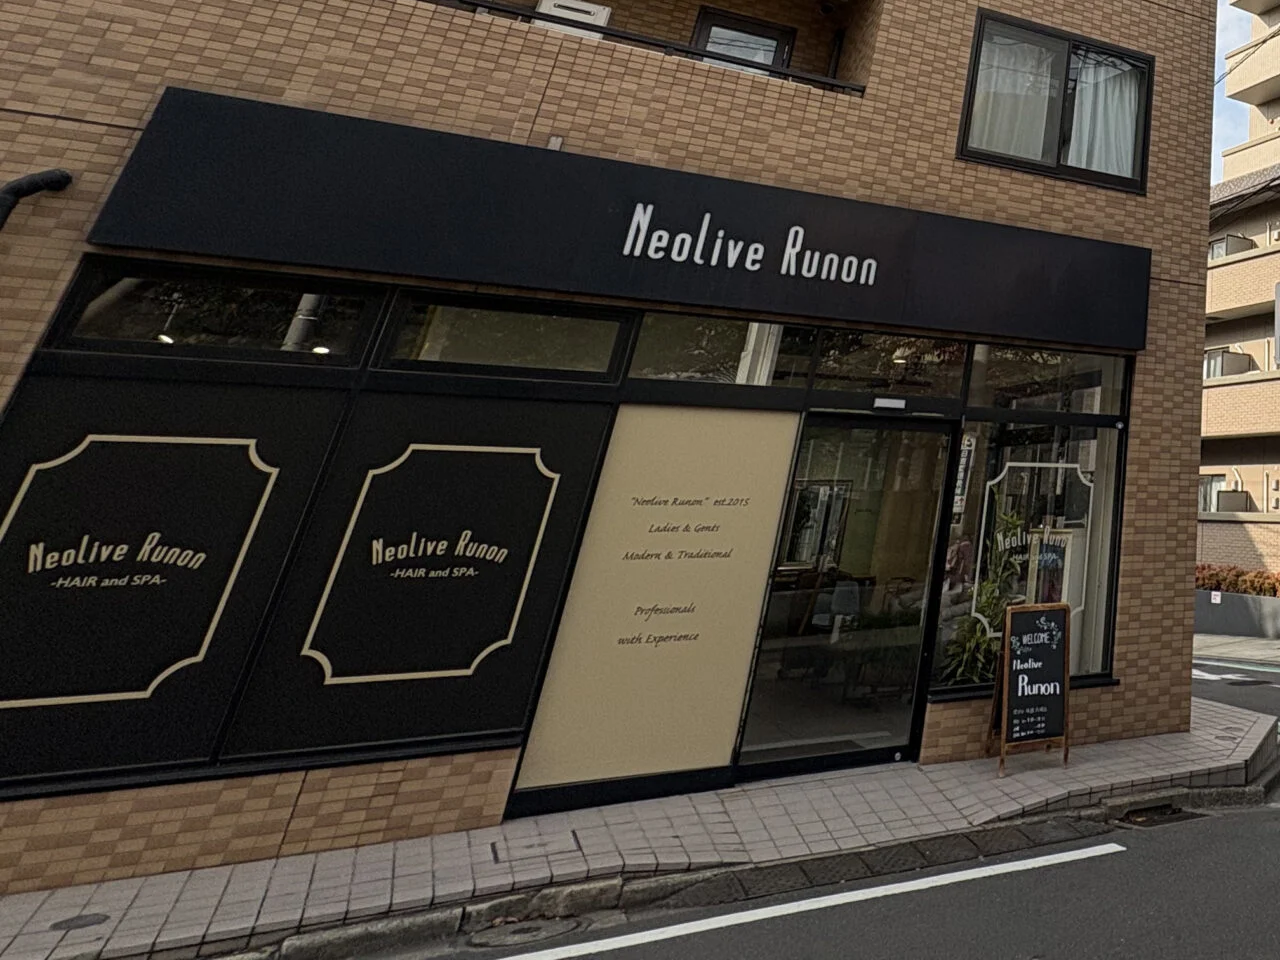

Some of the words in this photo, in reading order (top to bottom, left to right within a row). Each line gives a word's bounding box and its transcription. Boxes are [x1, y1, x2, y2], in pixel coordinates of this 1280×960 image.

[622, 202, 765, 271] Neolive
[780, 225, 878, 286] Runon
[648, 522, 680, 533] Ladies
[682, 524, 691, 533] &
[694, 522, 720, 533] Gents
[28, 535, 129, 574] Neolive
[136, 532, 207, 570] Runon
[372, 532, 448, 565] Neolive
[454, 530, 508, 563] Runon
[622, 549, 661, 561] Modern
[664, 550, 674, 560] &
[677, 548, 733, 560] Traditional
[428, 568, 450, 578] and
[100, 576, 129, 587] and
[634, 602, 696, 622] Professionals
[617, 633, 642, 645] with
[645, 633, 699, 648] Experience
[1022, 632, 1050, 645] WELCOME
[1017, 673, 1060, 697] Runon
